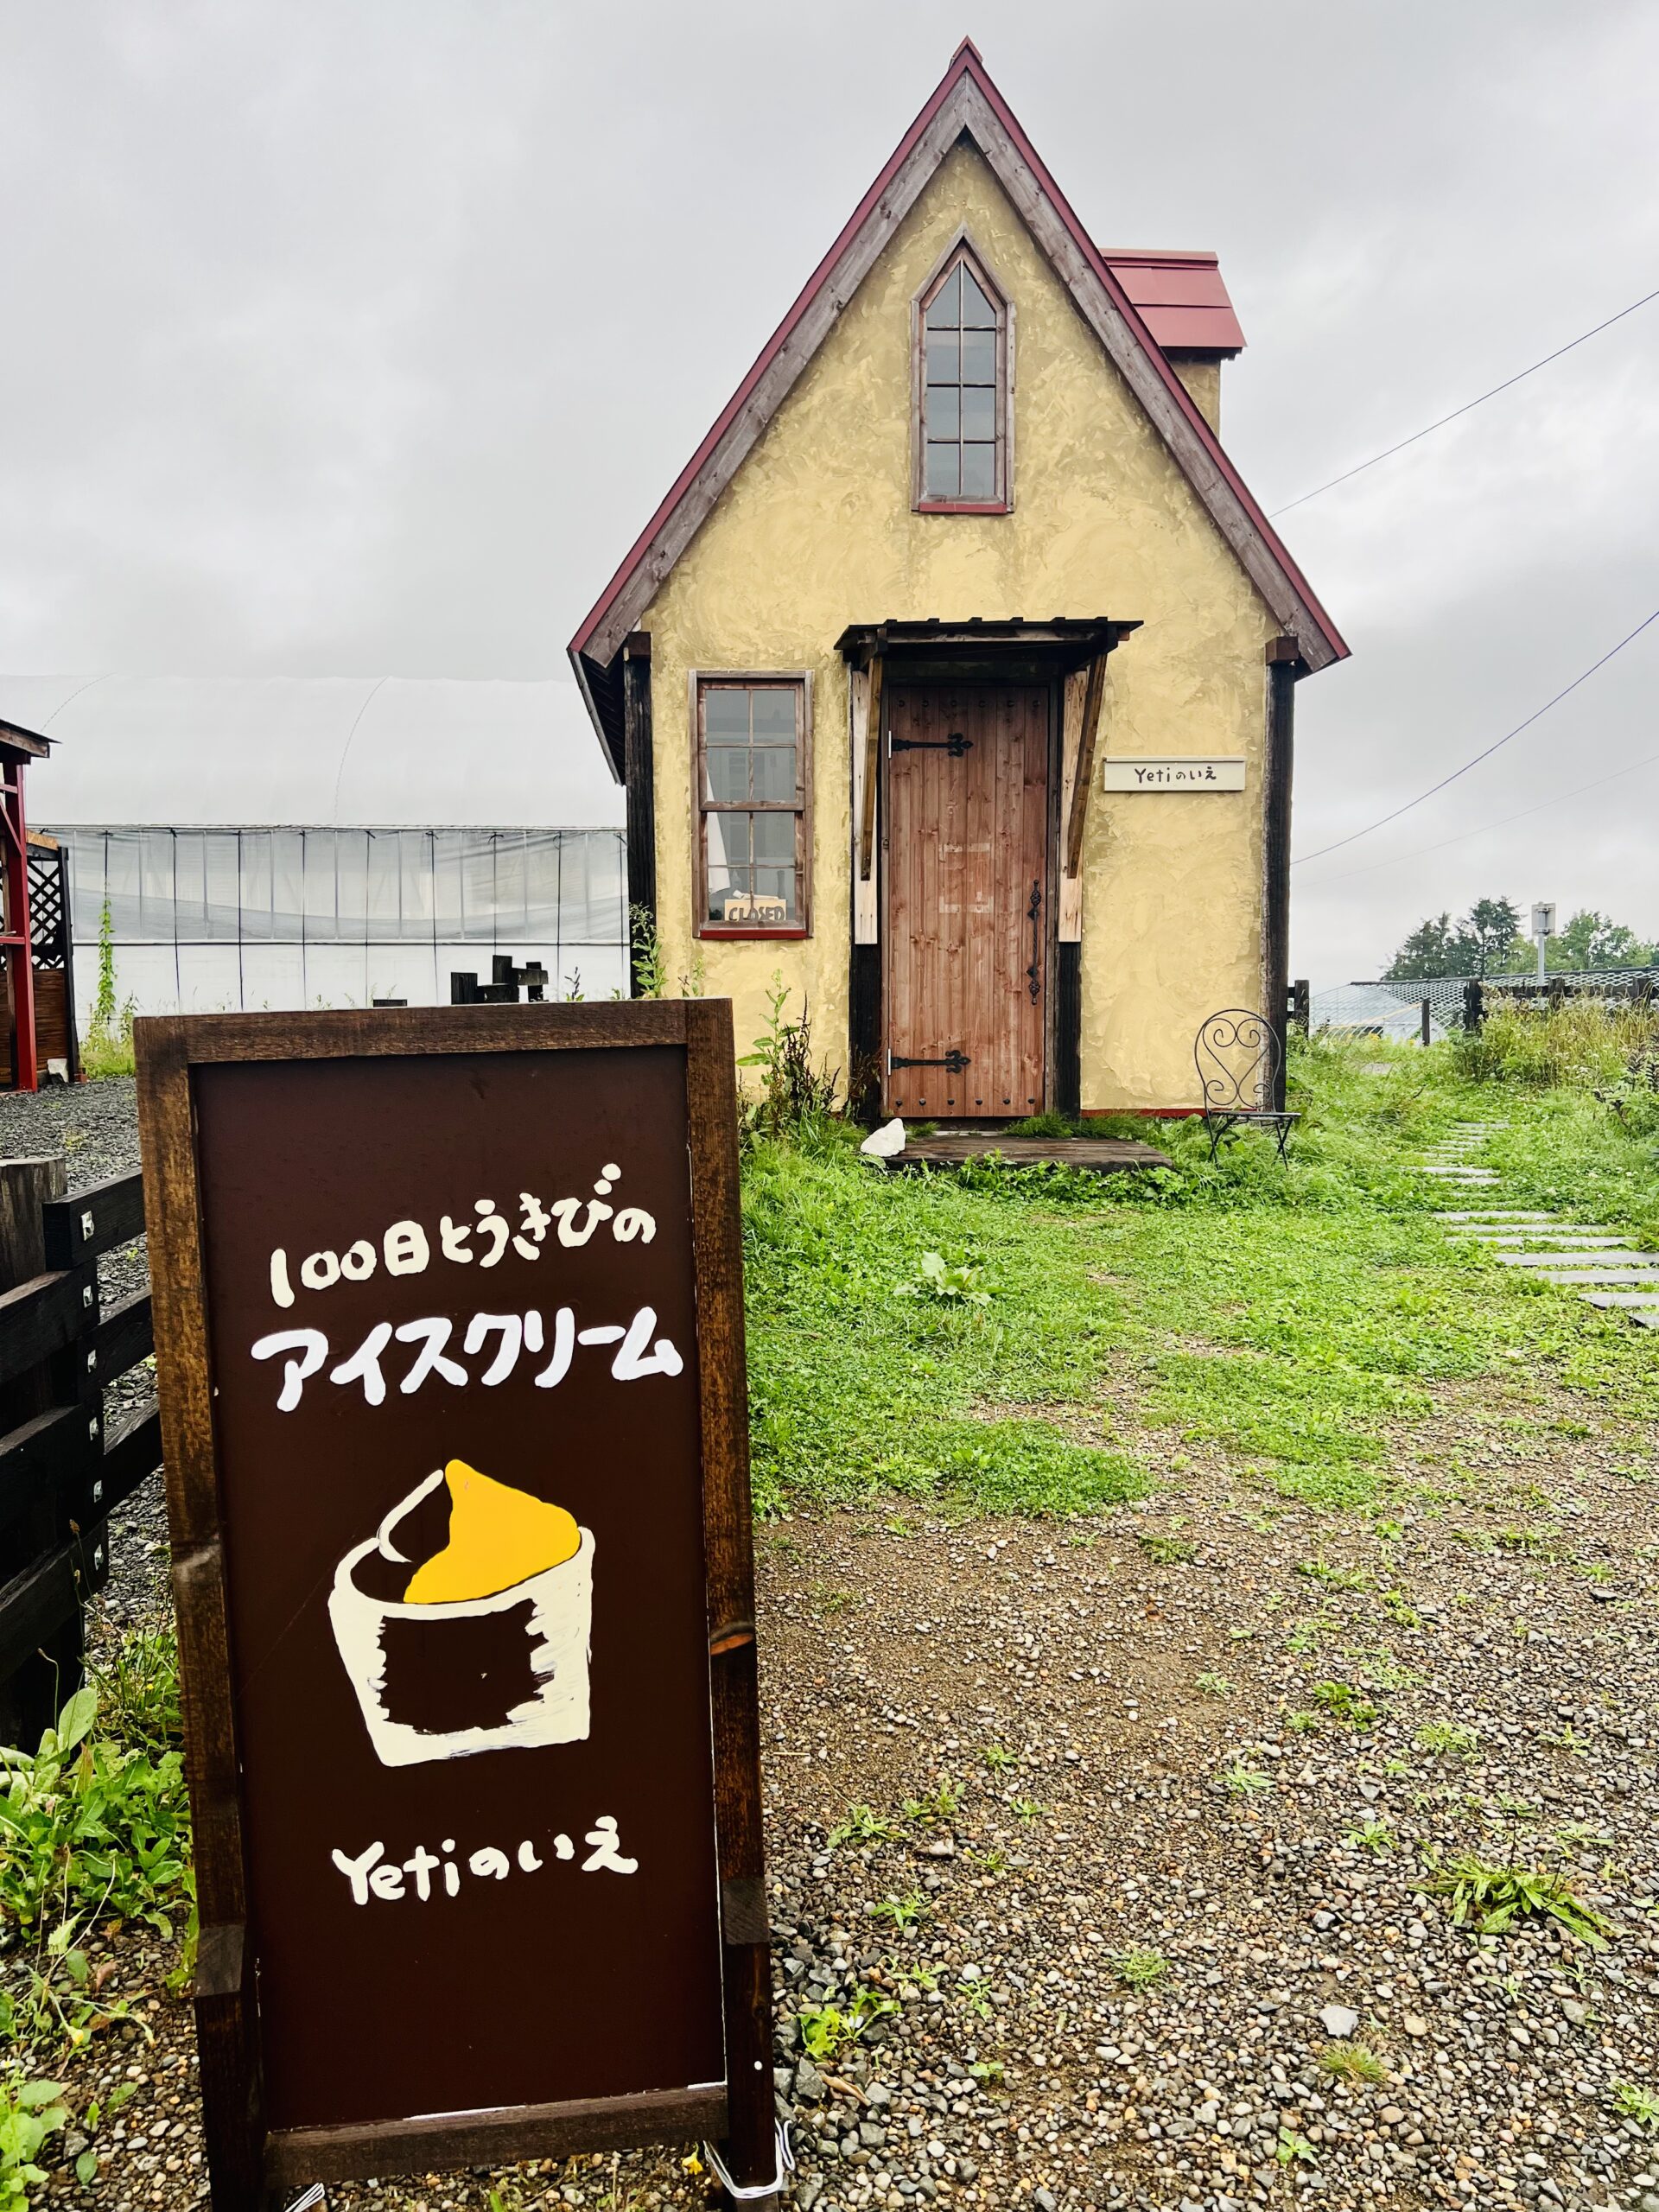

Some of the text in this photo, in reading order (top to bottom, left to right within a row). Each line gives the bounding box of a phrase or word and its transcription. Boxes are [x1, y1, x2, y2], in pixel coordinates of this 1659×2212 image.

[1134, 766, 1217, 784] Yetiのいえ
[728, 906, 785, 921] CLOSED
[270, 1163, 657, 1308] 100日とうきびの
[251, 1306, 683, 1413] アイスクリーム
[331, 1815, 639, 1905] Yetiのいえ
